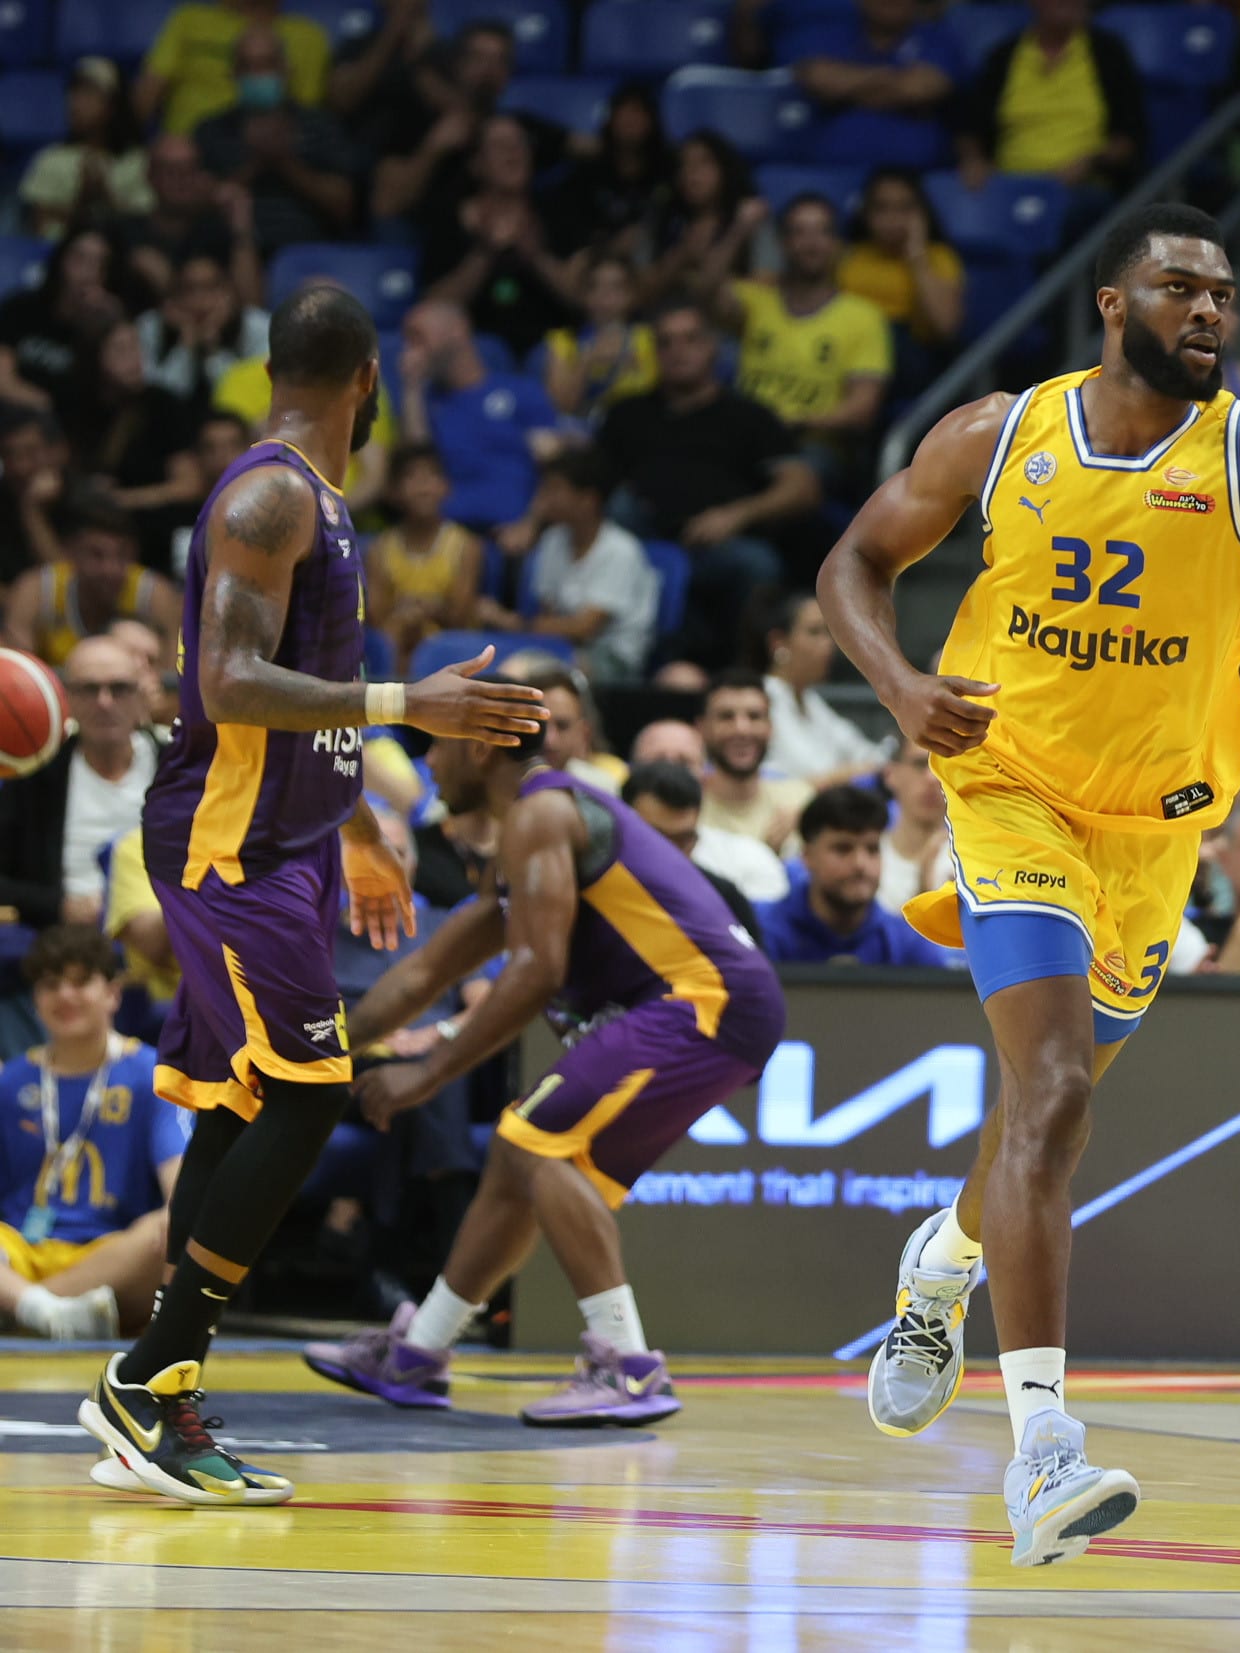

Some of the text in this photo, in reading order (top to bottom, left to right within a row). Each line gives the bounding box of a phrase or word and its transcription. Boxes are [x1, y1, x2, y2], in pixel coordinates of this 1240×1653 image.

[1150, 494, 1195, 509] Winner
[1052, 536, 1145, 609] 32
[1008, 604, 1189, 671] Playtika
[1190, 787, 1204, 800] XL
[1014, 870, 1066, 889] Rapyd
[1127, 940, 1169, 998] 3
[303, 1017, 335, 1032] Reebok
[630, 1169, 754, 1205] ement
[760, 1166, 837, 1206] that
